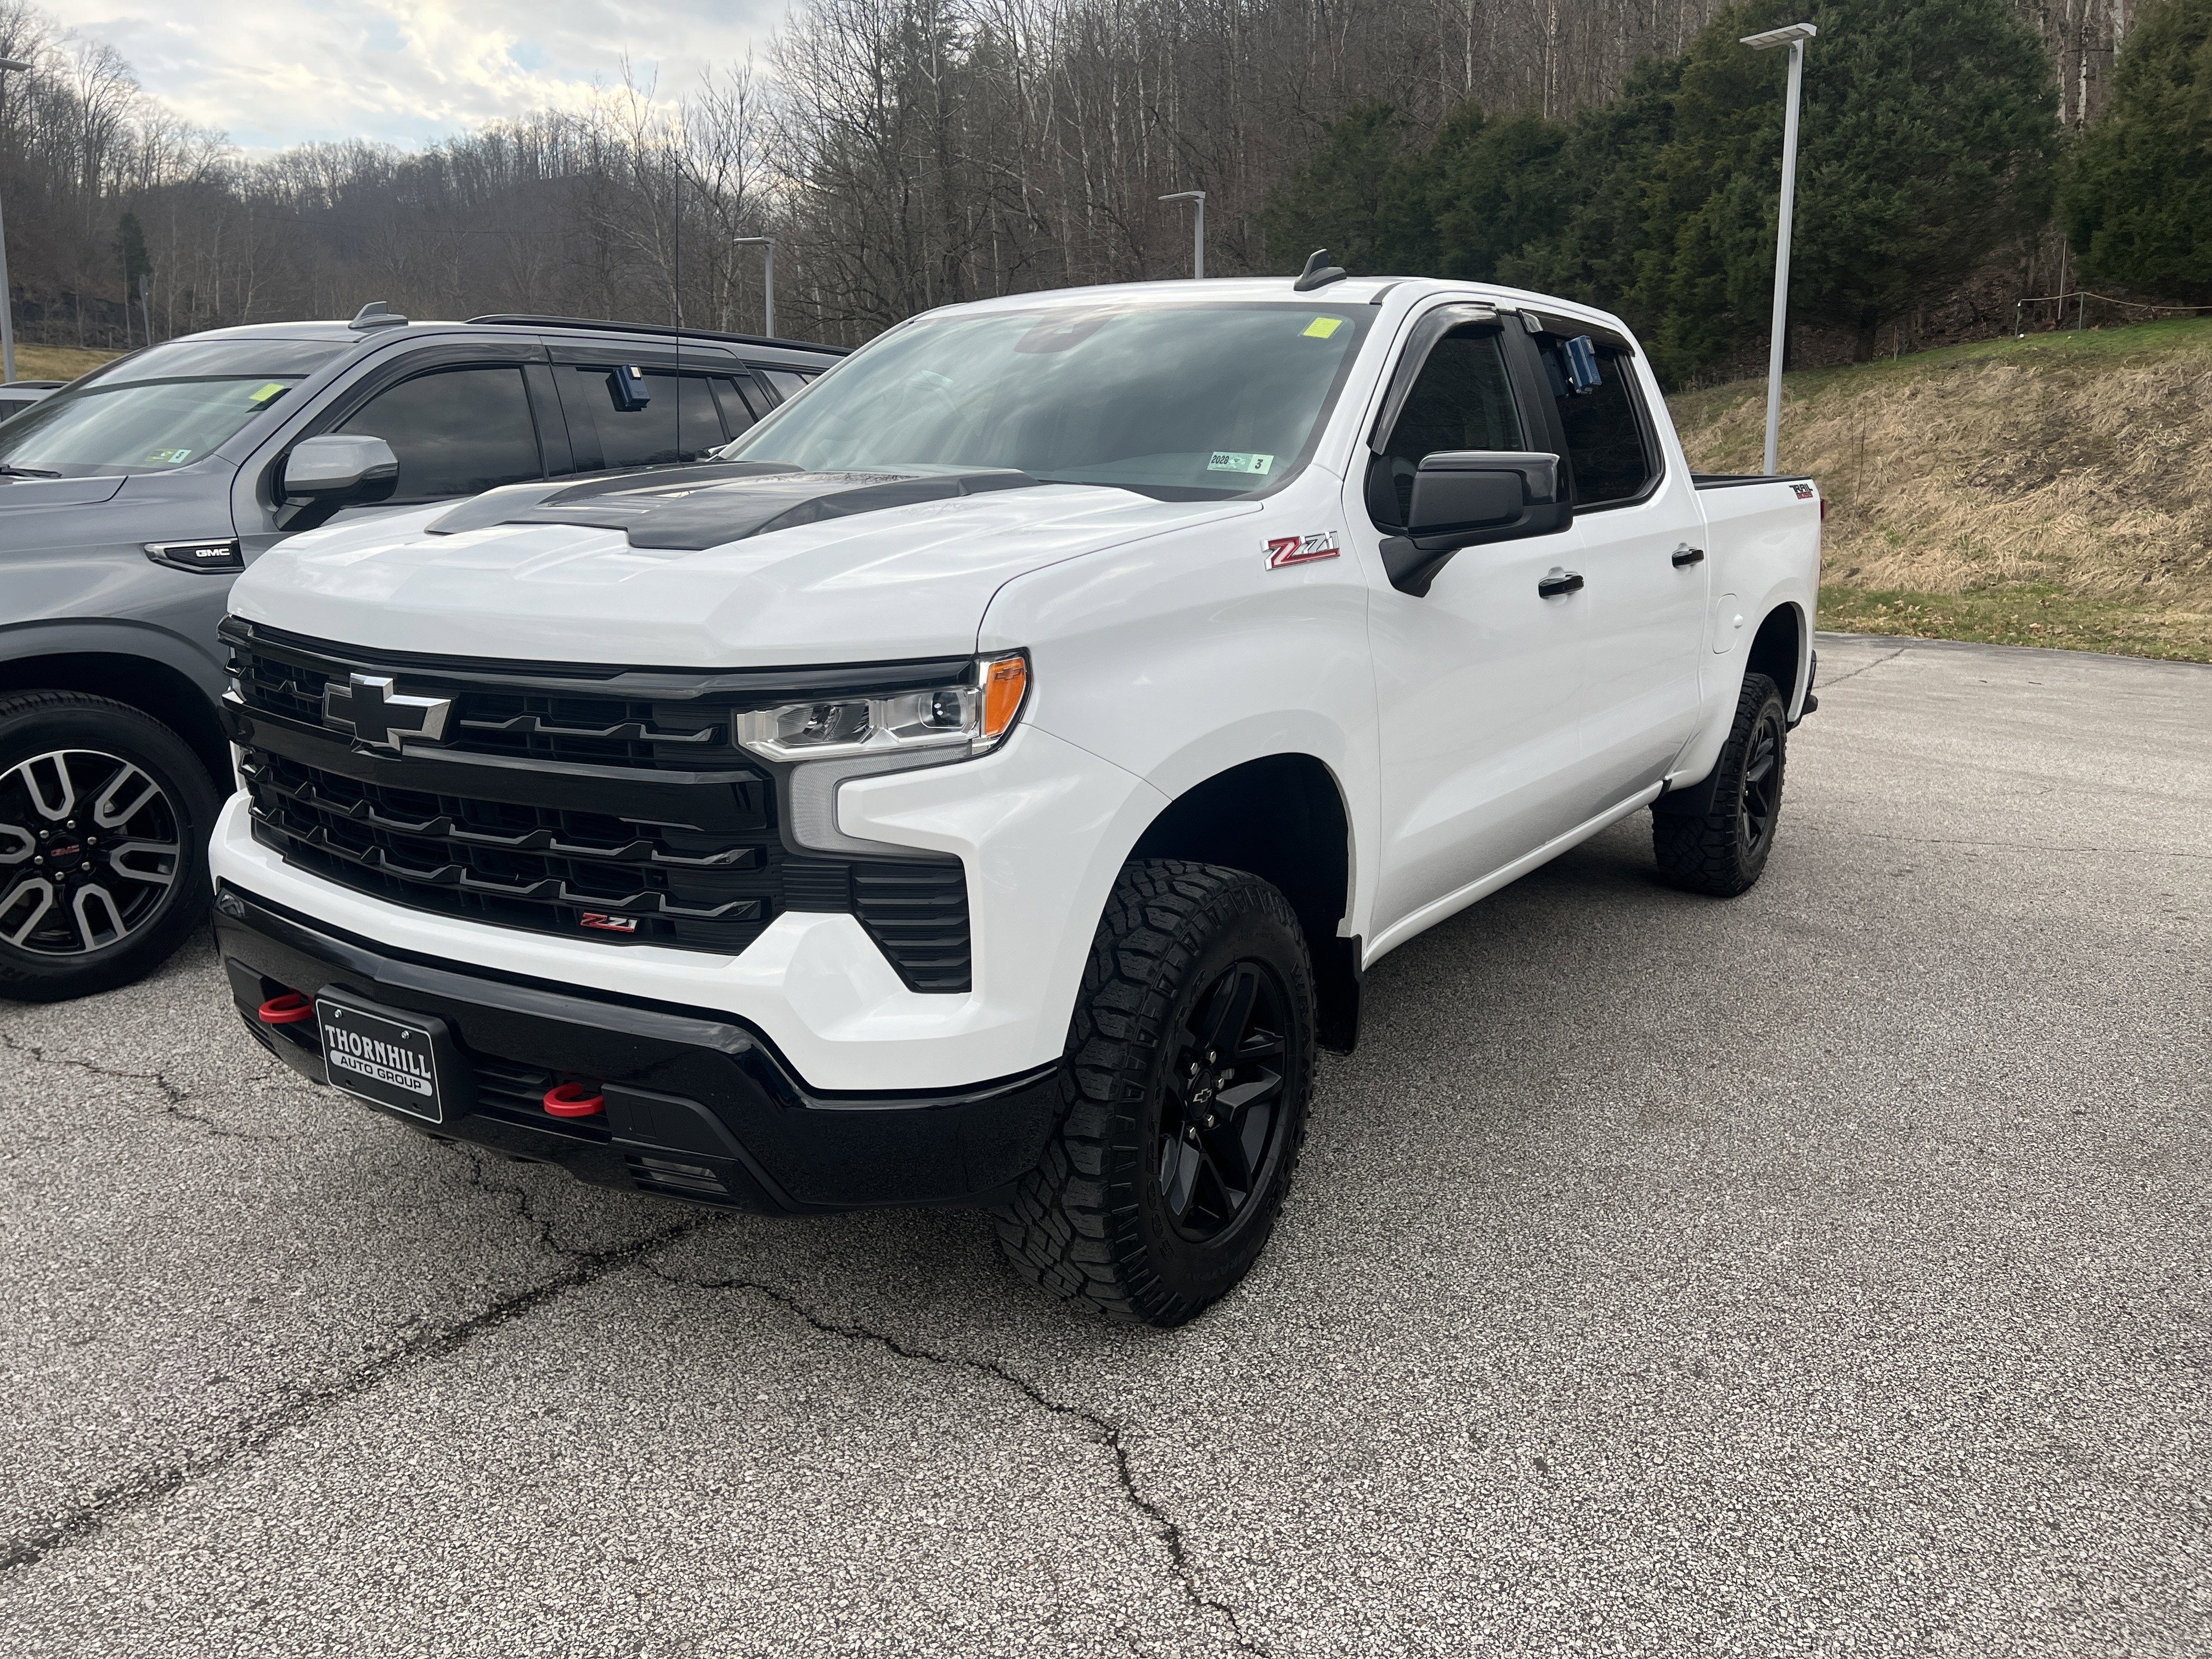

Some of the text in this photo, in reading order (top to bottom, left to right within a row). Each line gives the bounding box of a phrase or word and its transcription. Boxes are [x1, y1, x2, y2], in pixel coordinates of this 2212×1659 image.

[1255, 459, 1263, 469] 3
[1788, 483, 1813, 493] TRAIL
[195, 548, 230, 557] GMC
[1260, 531, 1340, 571] Z71
[50, 844, 80, 857] GMC
[580, 912, 637, 933] Z71
[324, 1024, 432, 1079] THORNHILL
[340, 1056, 422, 1089] AUTO GROUP
